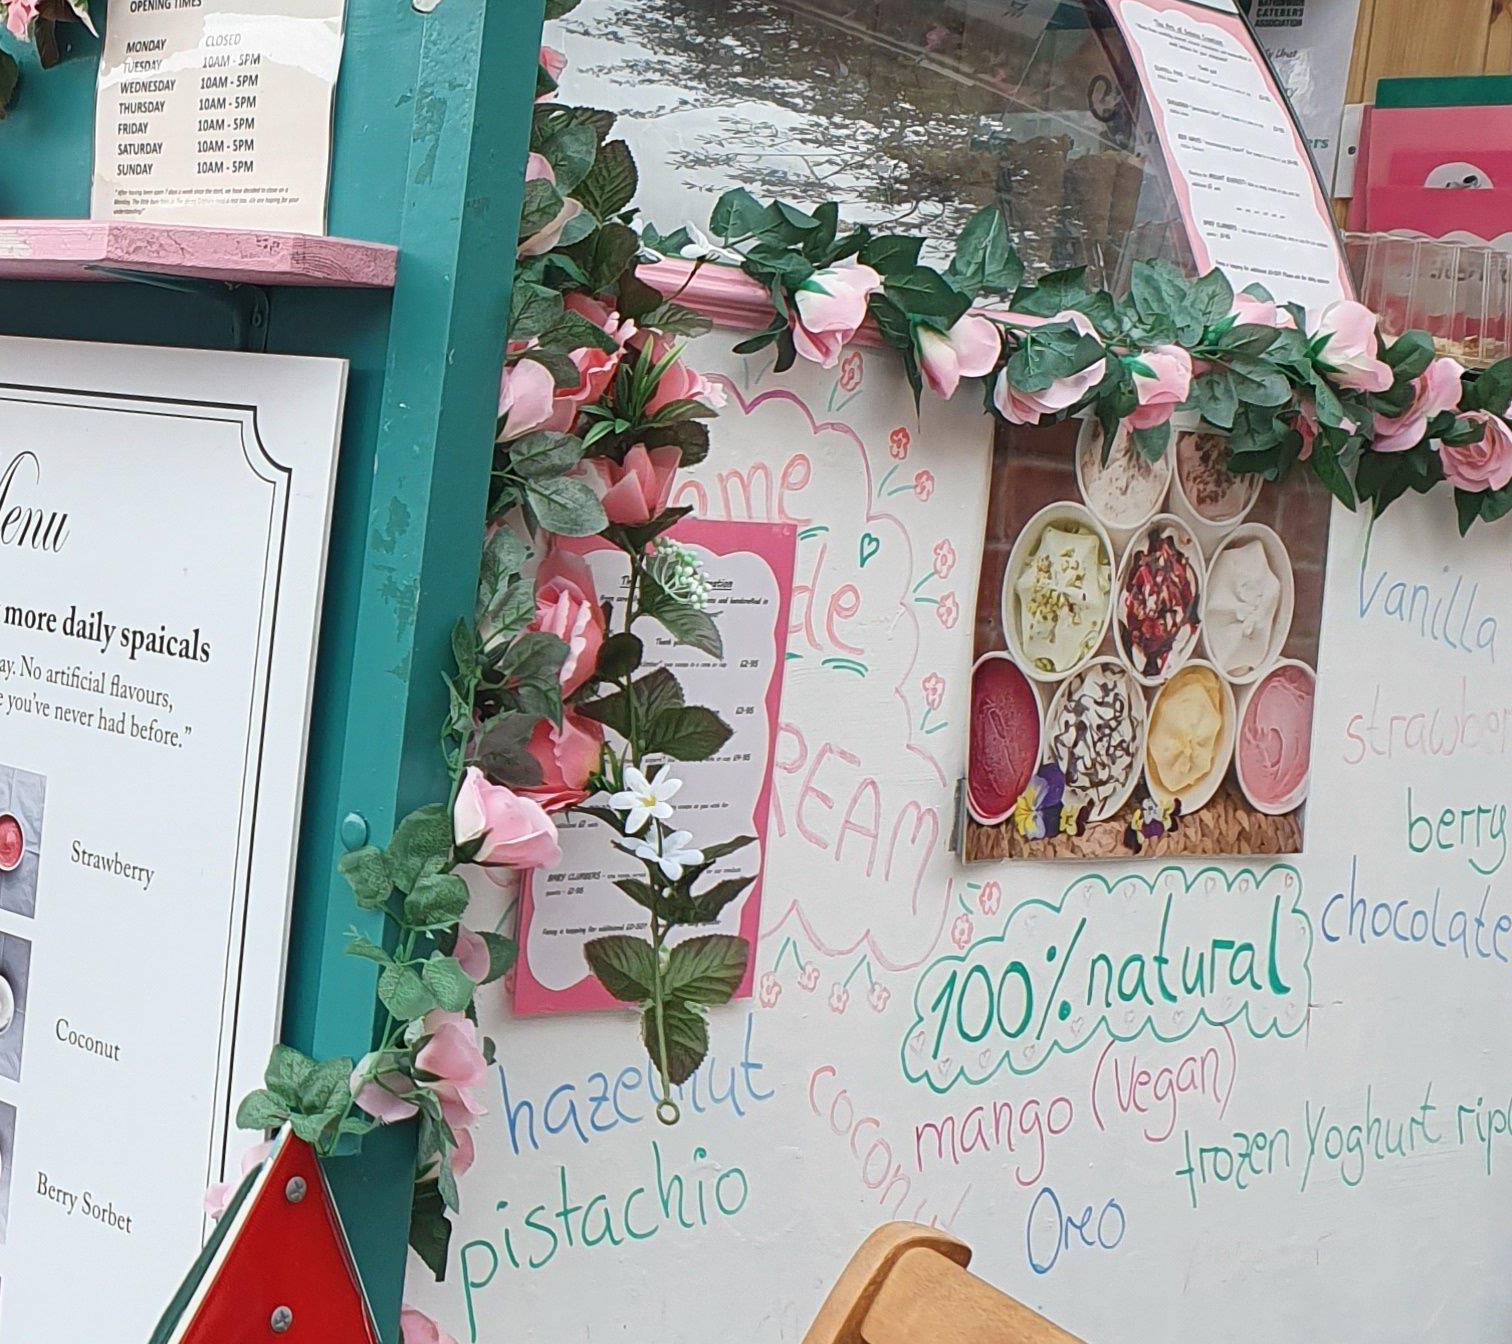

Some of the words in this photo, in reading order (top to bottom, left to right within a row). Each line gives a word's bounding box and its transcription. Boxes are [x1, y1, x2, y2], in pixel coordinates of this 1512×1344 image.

[122, 58, 163, 74] TUESDAY
[202, 54, 231, 69] 10AM
[238, 52, 261, 67] 5PM
[126, 38, 167, 55] MONDAY
[205, 32, 242, 49] CLOSED
[118, 99, 166, 115] THURSDAY
[198, 96, 227, 111] 10AM
[234, 94, 257, 109] 5PM
[120, 77, 176, 95] WEDNESDAY
[200, 74, 229, 90] 10AM
[236, 72, 259, 88] 5PM
[117, 120, 149, 135] FRIDAY
[197, 117, 225, 133] 10AM
[232, 116, 255, 131] 5PM
[117, 140, 163, 157] SATURDAY
[196, 139, 225, 154] 10AM
[232, 137, 255, 153] 5PM
[116, 161, 154, 177] SUNDAY
[196, 159, 225, 175] 10AM
[231, 158, 255, 174] 5PM
[672, 452, 813, 524] ome
[4, 605, 58, 634] more
[62, 604, 116, 656] daily
[120, 625, 211, 664] spaicals
[20, 654, 42, 681] No
[45, 664, 106, 696] artificial
[109, 673, 175, 713] flavours,
[54, 703, 95, 729] never
[98, 706, 126, 735] had
[1343, 675, 1512, 767] strawber
[1407, 786, 1508, 876] berry
[71, 840, 155, 891] Strawberry
[1321, 855, 1512, 964] chocolate
[929, 917, 1086, 1060] 100%
[1086, 893, 1291, 1007] natural
[55, 1018, 121, 1062] Coconut
[914, 1096, 1073, 1187] mango
[1175, 1127, 1291, 1208] frozen
[36, 1171, 78, 1216] Berry
[81, 1191, 133, 1236] Sorbet
[1025, 1187, 1126, 1274] Oreo
[459, 1140, 749, 1344] pistachio
